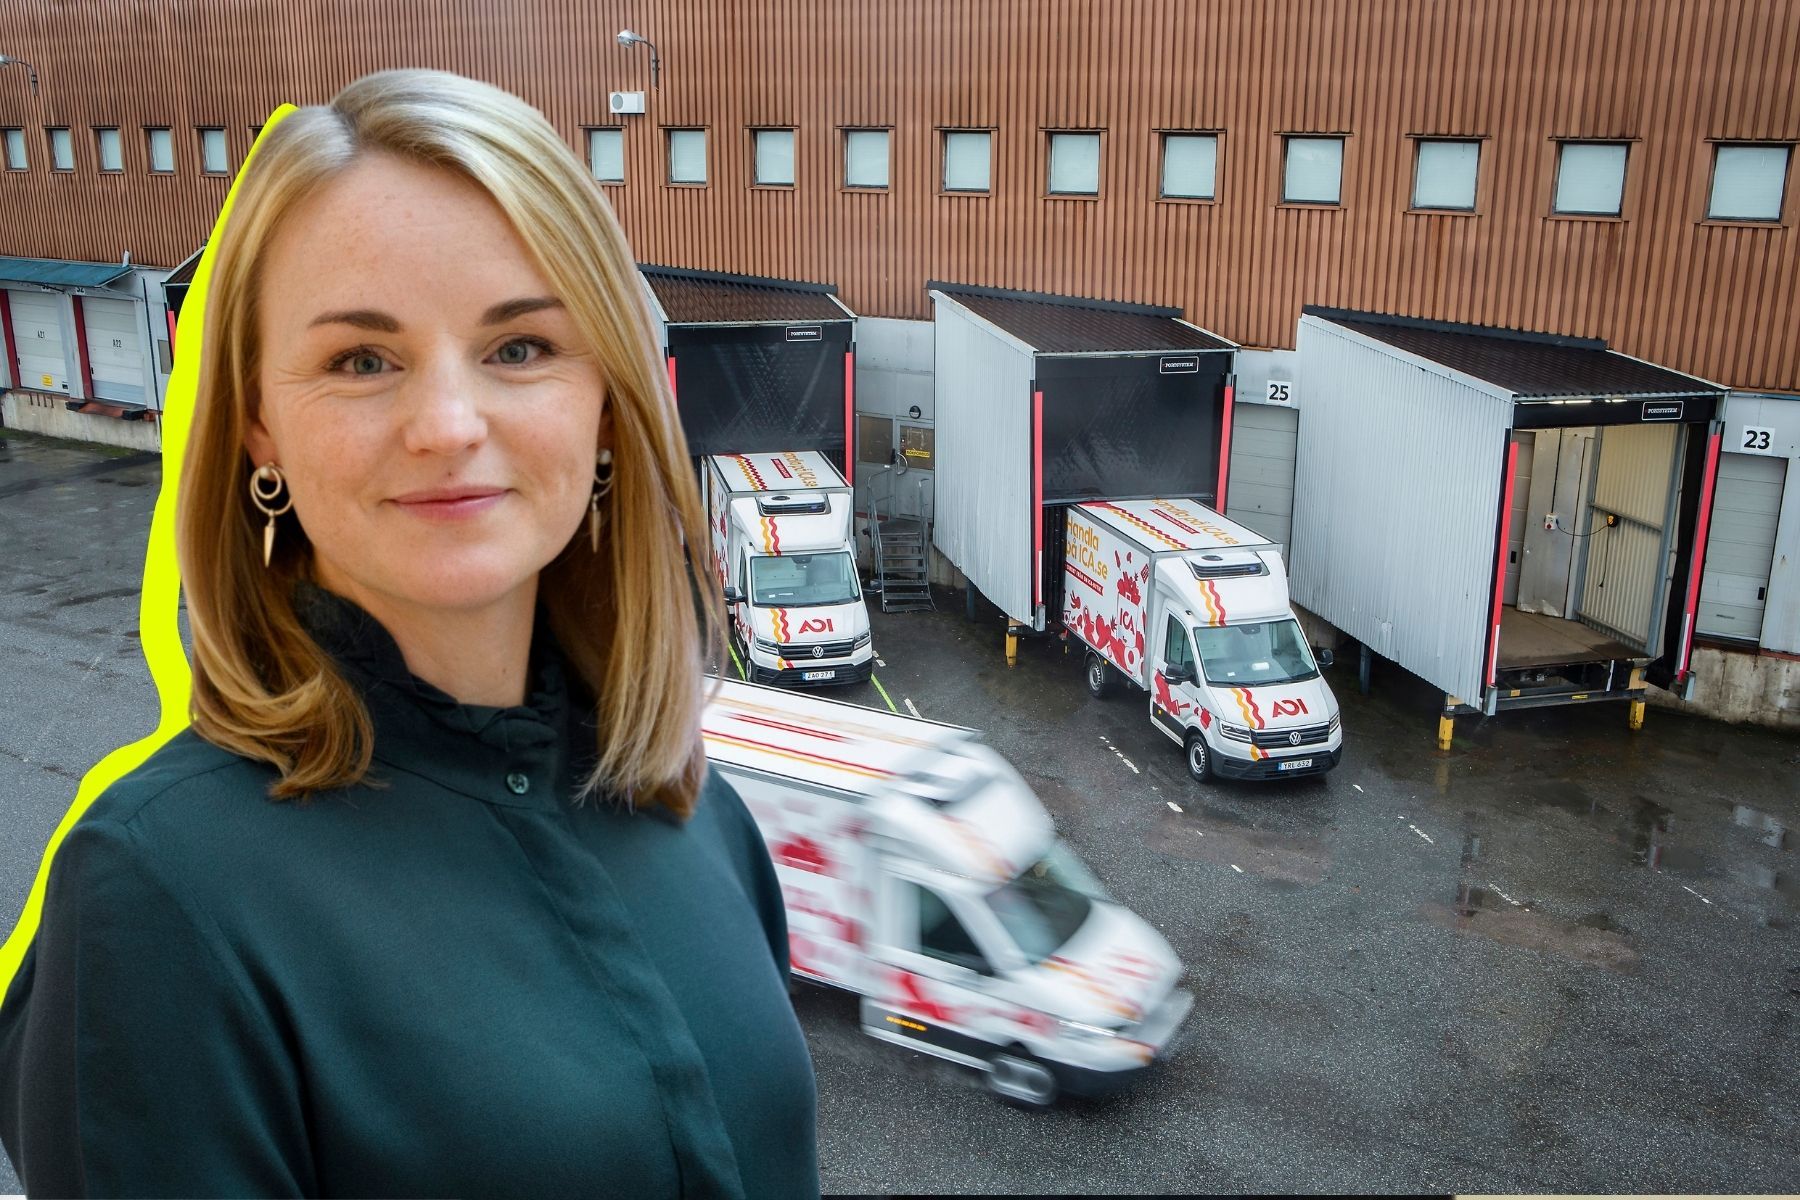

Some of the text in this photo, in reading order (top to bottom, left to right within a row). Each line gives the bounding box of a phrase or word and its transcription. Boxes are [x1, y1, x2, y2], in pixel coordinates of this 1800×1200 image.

[1269, 384, 1289, 401] 25
[1744, 430, 1770, 450] 23
[1079, 543, 1108, 580] ICA.se
[1120, 608, 1135, 635] ICA
